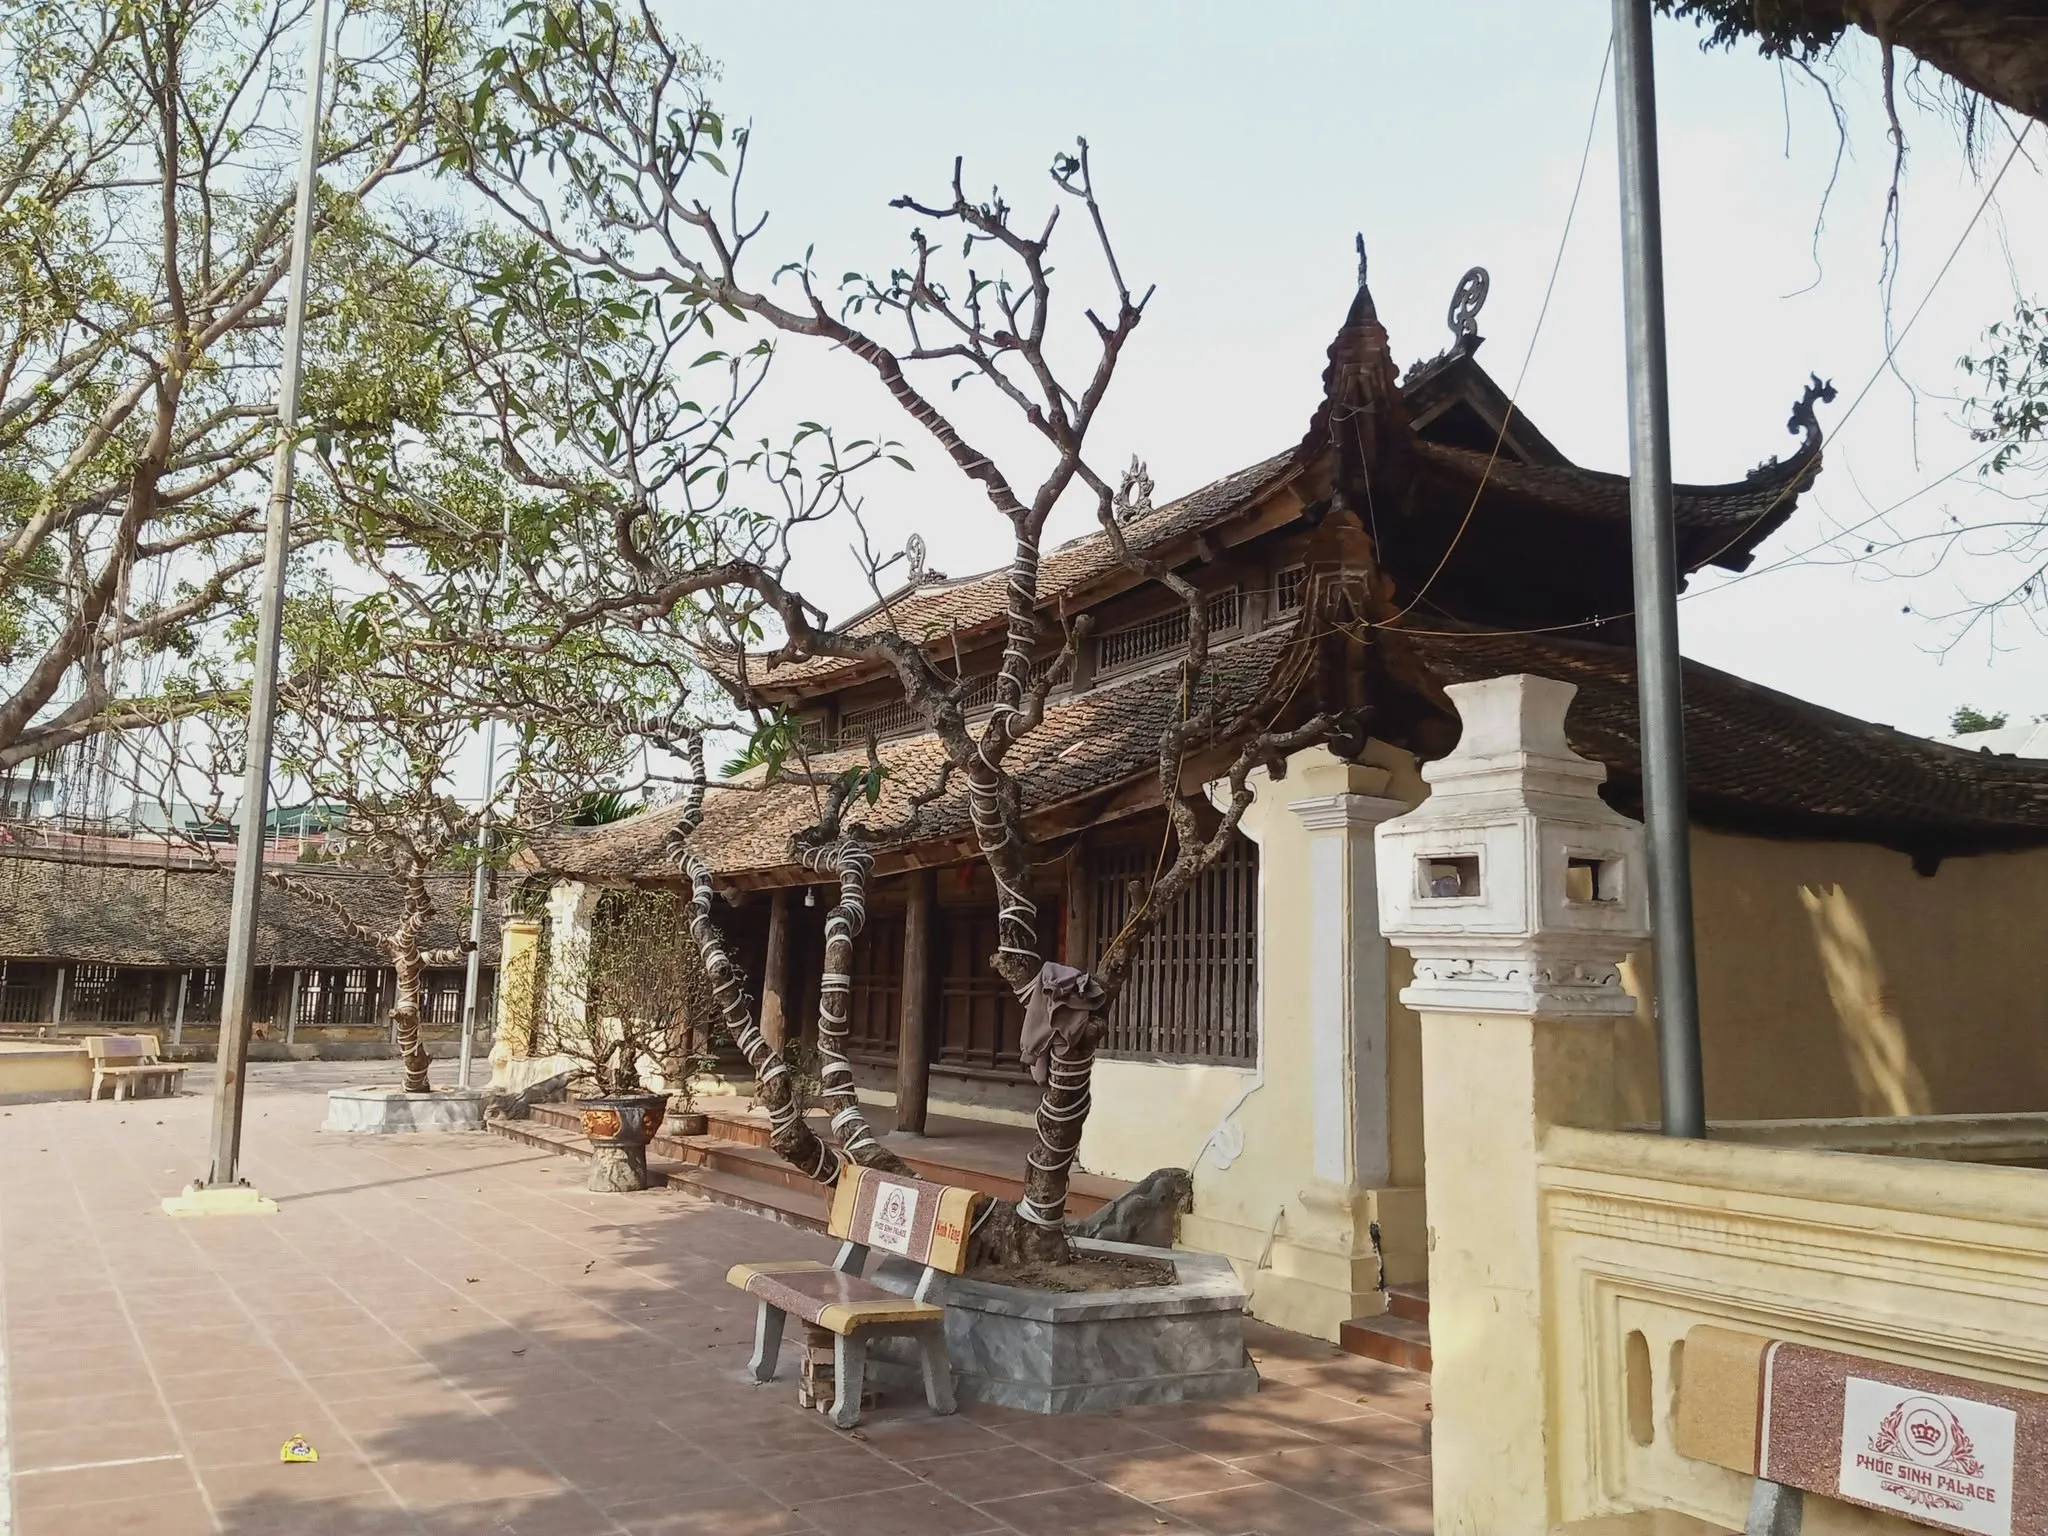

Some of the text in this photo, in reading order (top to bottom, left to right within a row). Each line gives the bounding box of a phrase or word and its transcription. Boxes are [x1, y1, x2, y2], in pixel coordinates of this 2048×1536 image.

[1856, 1454, 1996, 1503] PHÚC SINH PALACE
